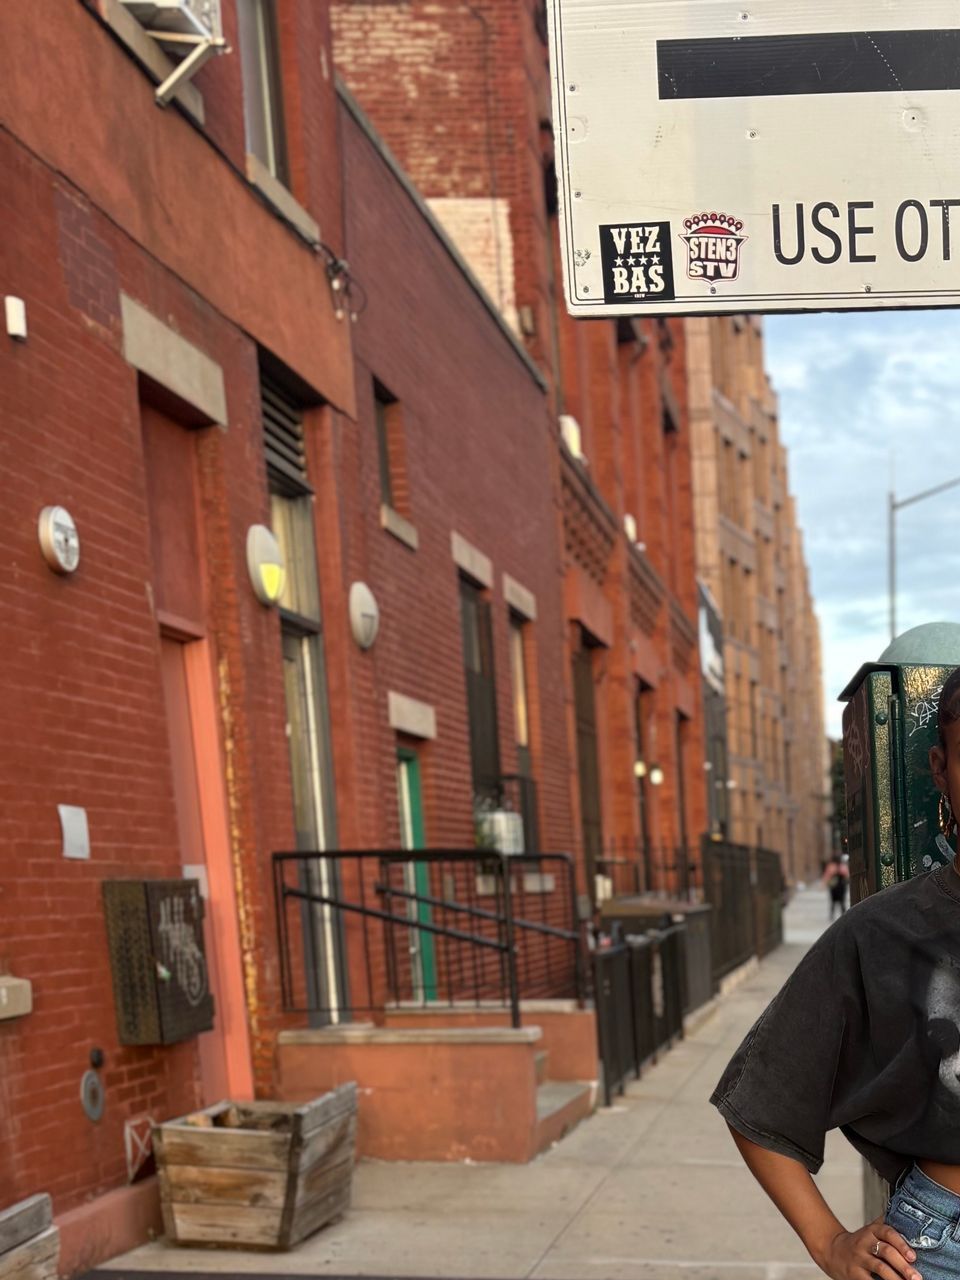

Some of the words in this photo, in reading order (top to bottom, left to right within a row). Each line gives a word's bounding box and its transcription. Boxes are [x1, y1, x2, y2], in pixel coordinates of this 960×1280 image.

[610, 226, 660, 254] VEZ
[772, 201, 877, 265] USE
[612, 265, 665, 294] BAS
[689, 261, 736, 278] STV
